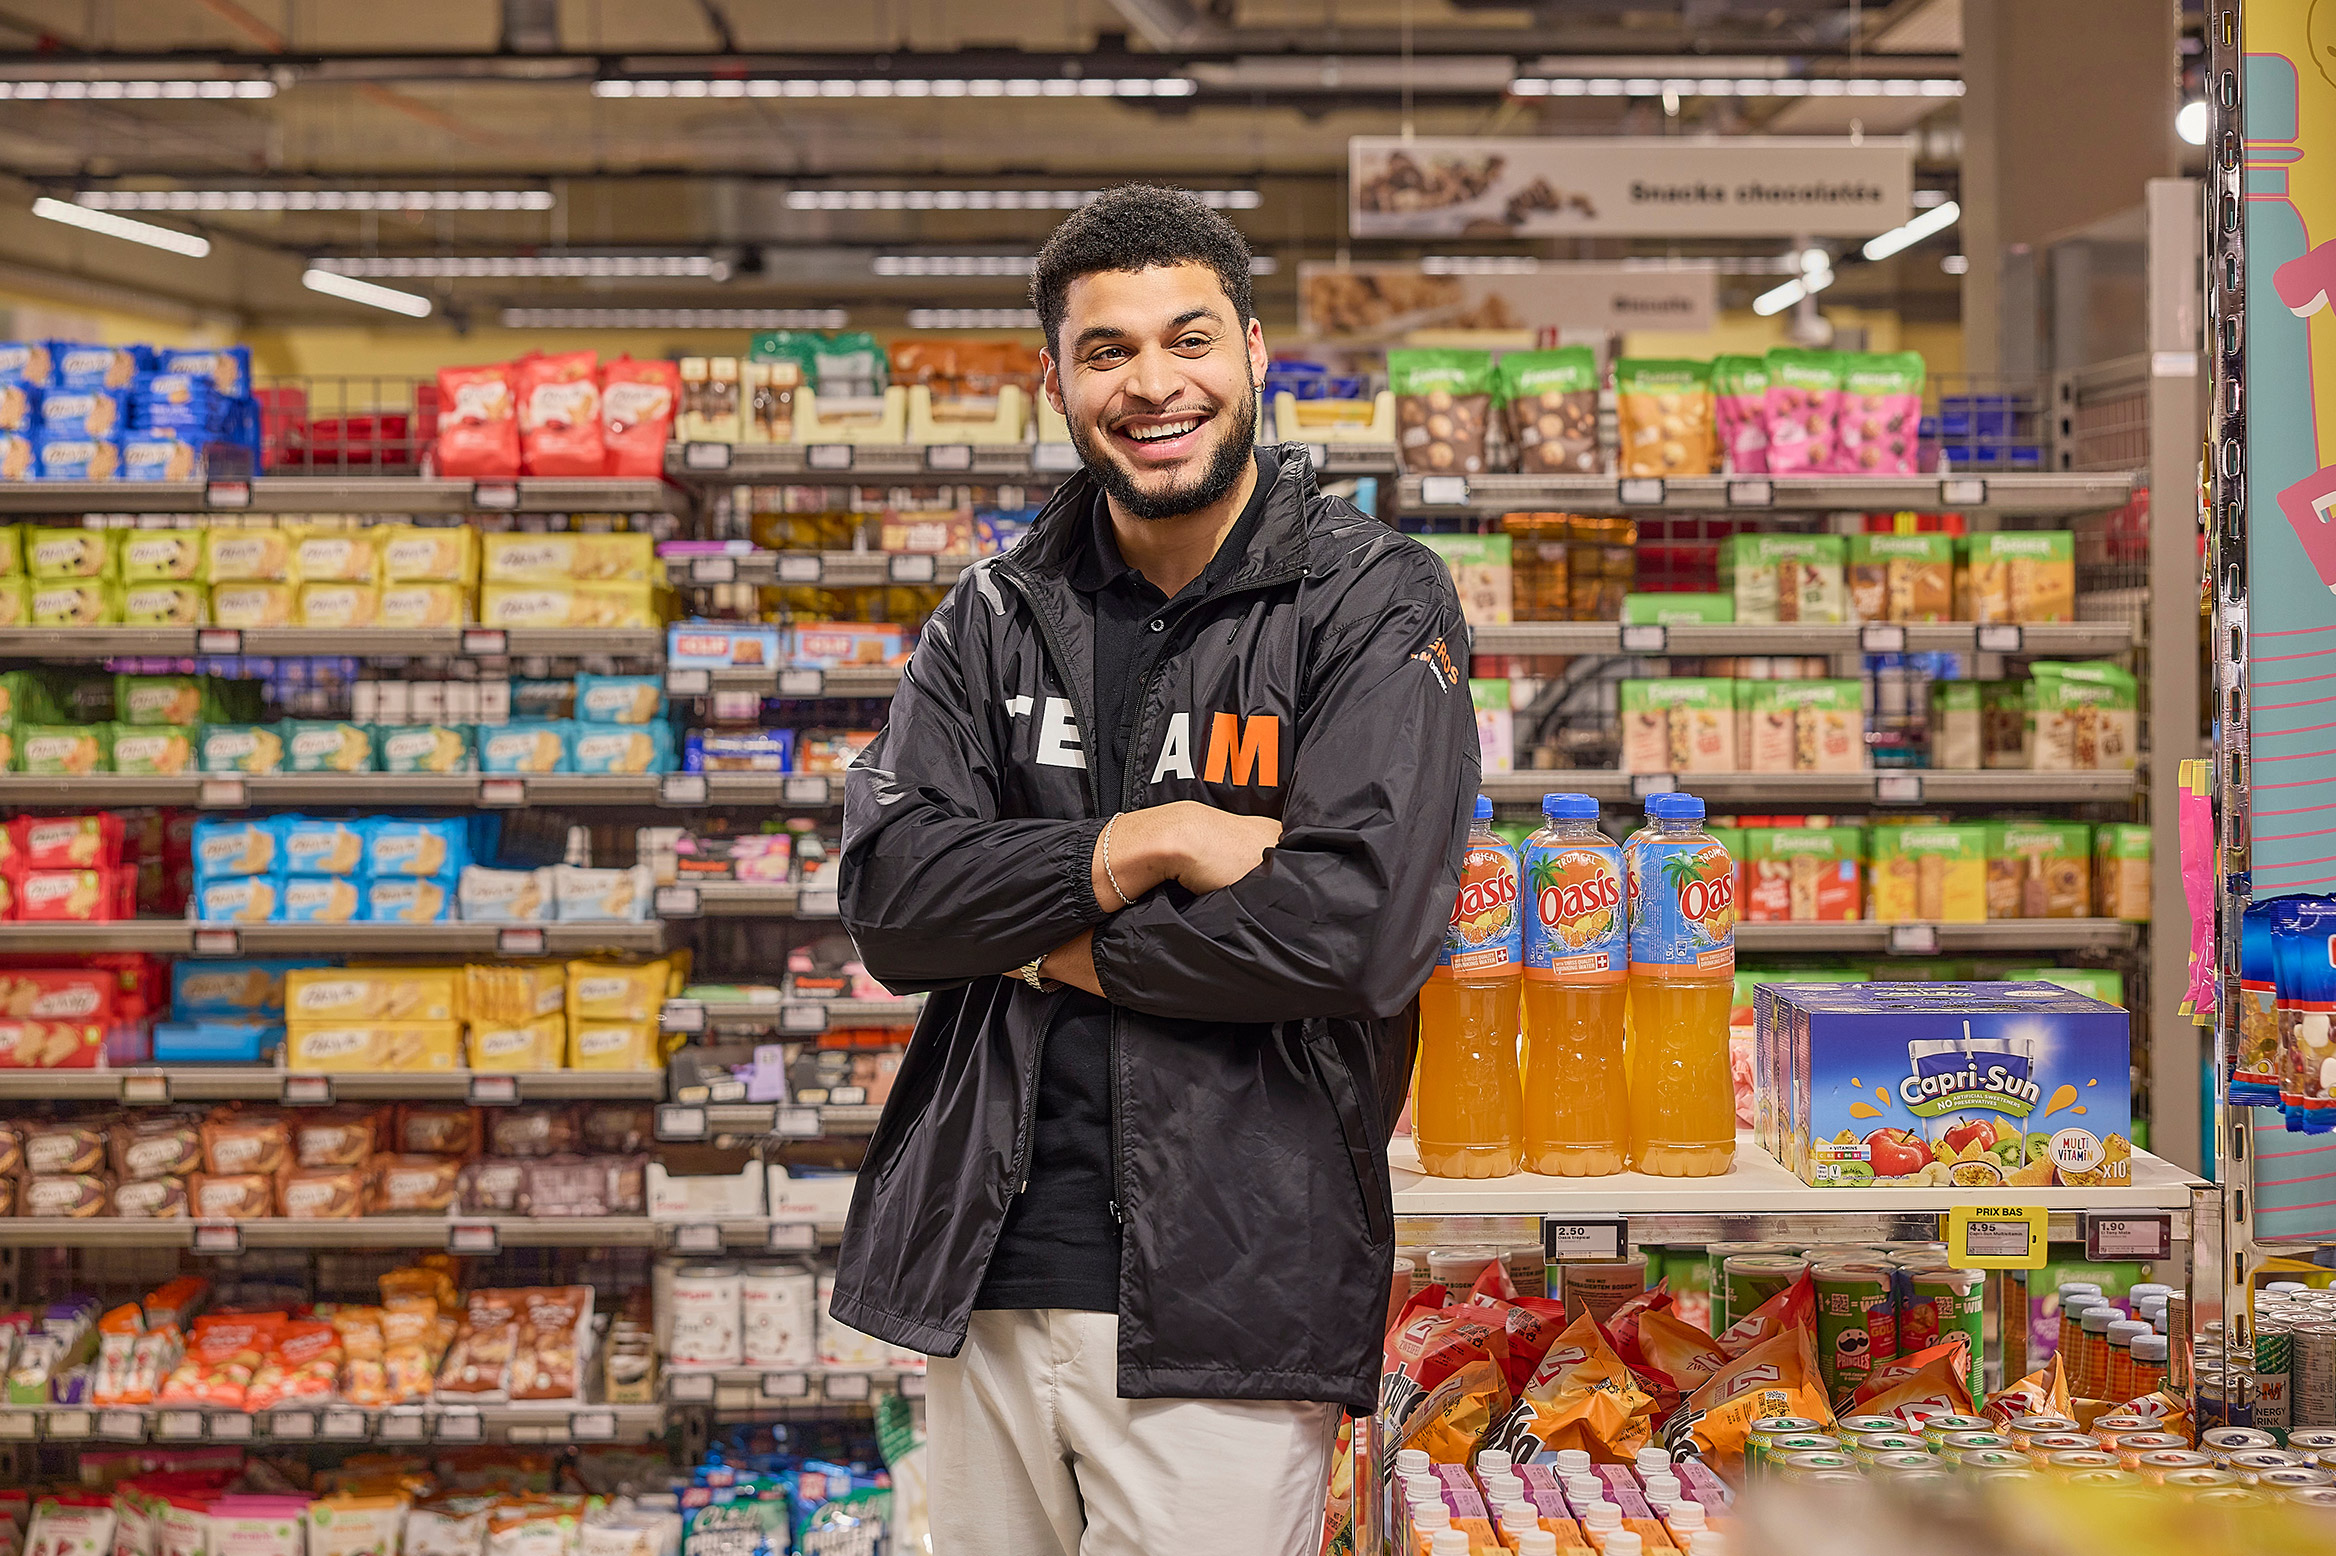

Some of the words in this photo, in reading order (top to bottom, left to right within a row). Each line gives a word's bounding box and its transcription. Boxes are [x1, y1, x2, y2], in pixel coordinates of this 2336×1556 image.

[1427, 637, 1459, 685] GROS
[1463, 852, 1499, 866] ROPICAL
[1556, 852, 1597, 869] TROPICAL
[1539, 867, 1620, 927] Oasis
[1900, 1062, 2040, 1105] Capri-Sun
[1937, 1099, 1953, 1110] NO
[1985, 1095, 2020, 1108] SWEETENERS
[2103, 1161, 2127, 1178] x10
[1976, 1208, 2000, 1216] PRIX
[2002, 1208, 2023, 1216] BAS
[1558, 1228, 1584, 1236] 2.50
[1970, 1224, 1996, 1232] 4.95
[2101, 1222, 2125, 1230] 1.90
[1836, 1354, 1870, 1370] PRINGLES
[2256, 1408, 2286, 1416] NERGY
[2257, 1417, 2280, 1426] RINK
